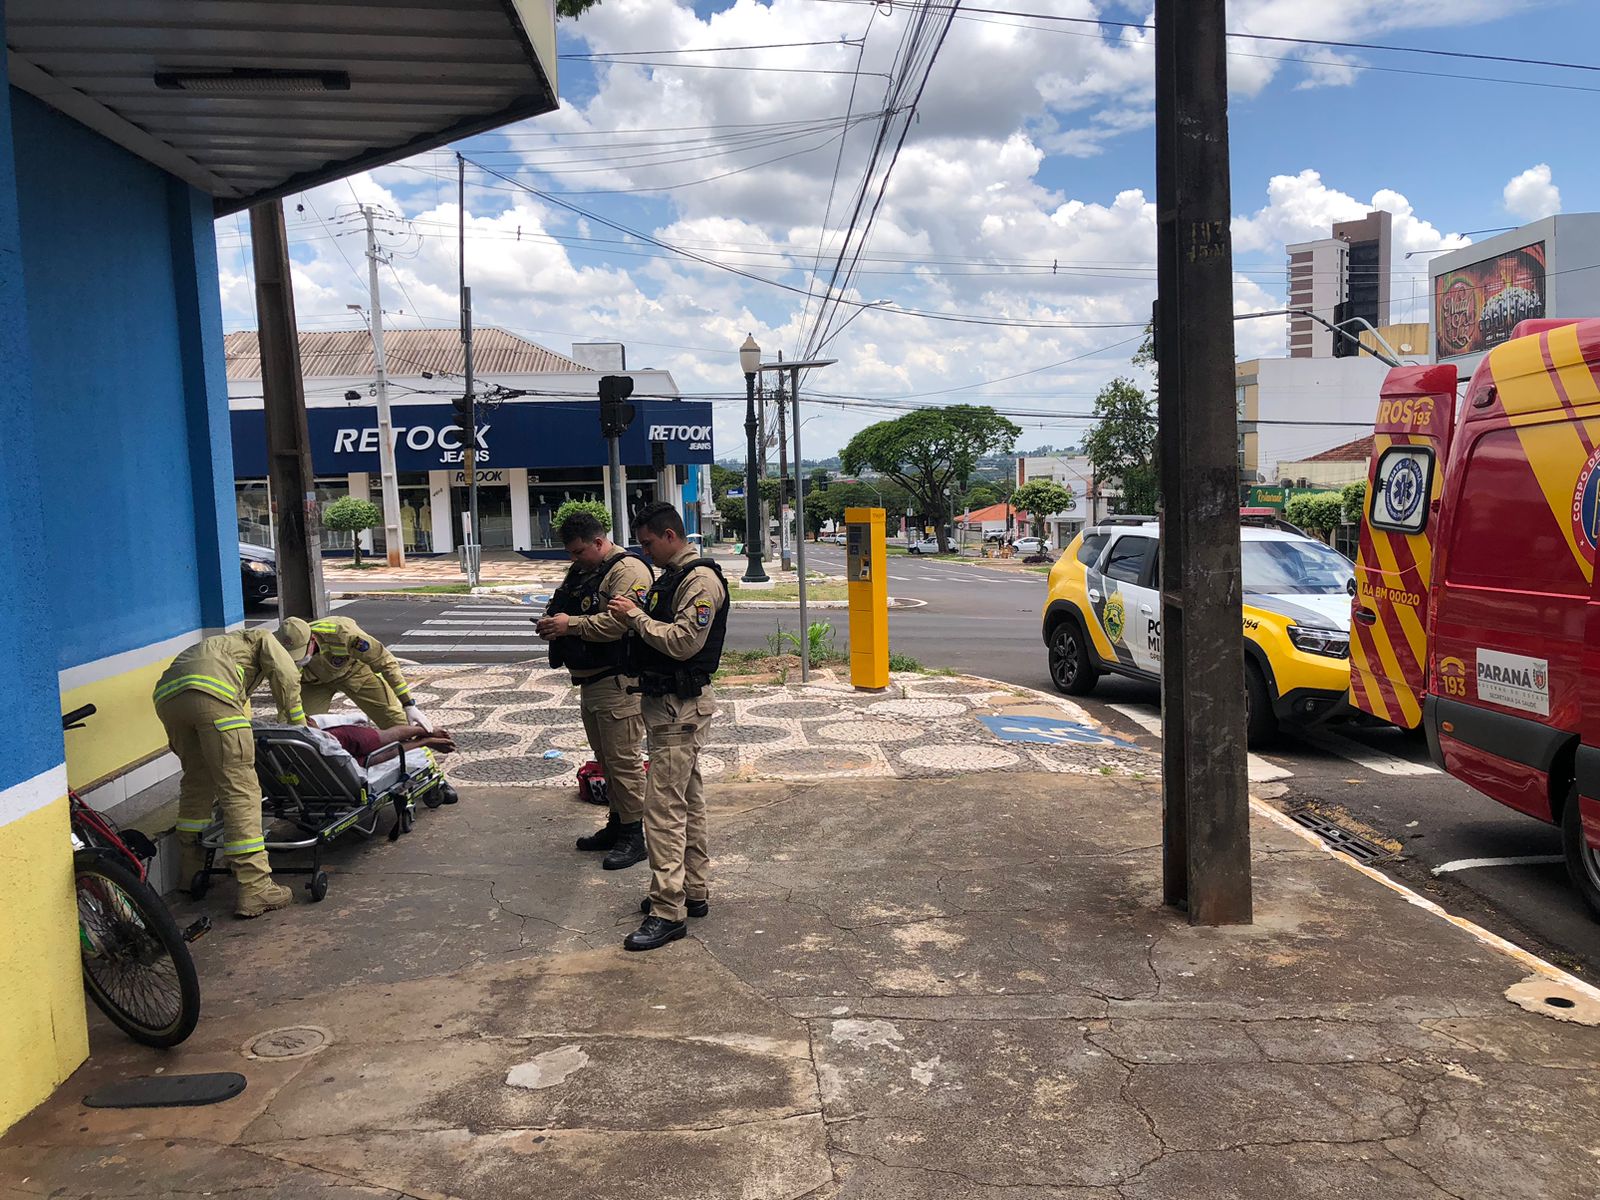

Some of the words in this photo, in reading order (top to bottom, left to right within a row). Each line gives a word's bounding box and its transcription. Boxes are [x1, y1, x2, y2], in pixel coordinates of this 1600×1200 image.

[1413, 411, 1431, 426] 193
[648, 425, 712, 441] RETOOK
[688, 442, 711, 450] JEANS
[455, 470, 502, 482] ROOK
[1573, 470, 1588, 521] CORPO
[1375, 586, 1388, 600] BM
[1389, 590, 1420, 606] 00020
[1478, 663, 1531, 688] PARANÁ
[1442, 675, 1466, 697] 193
